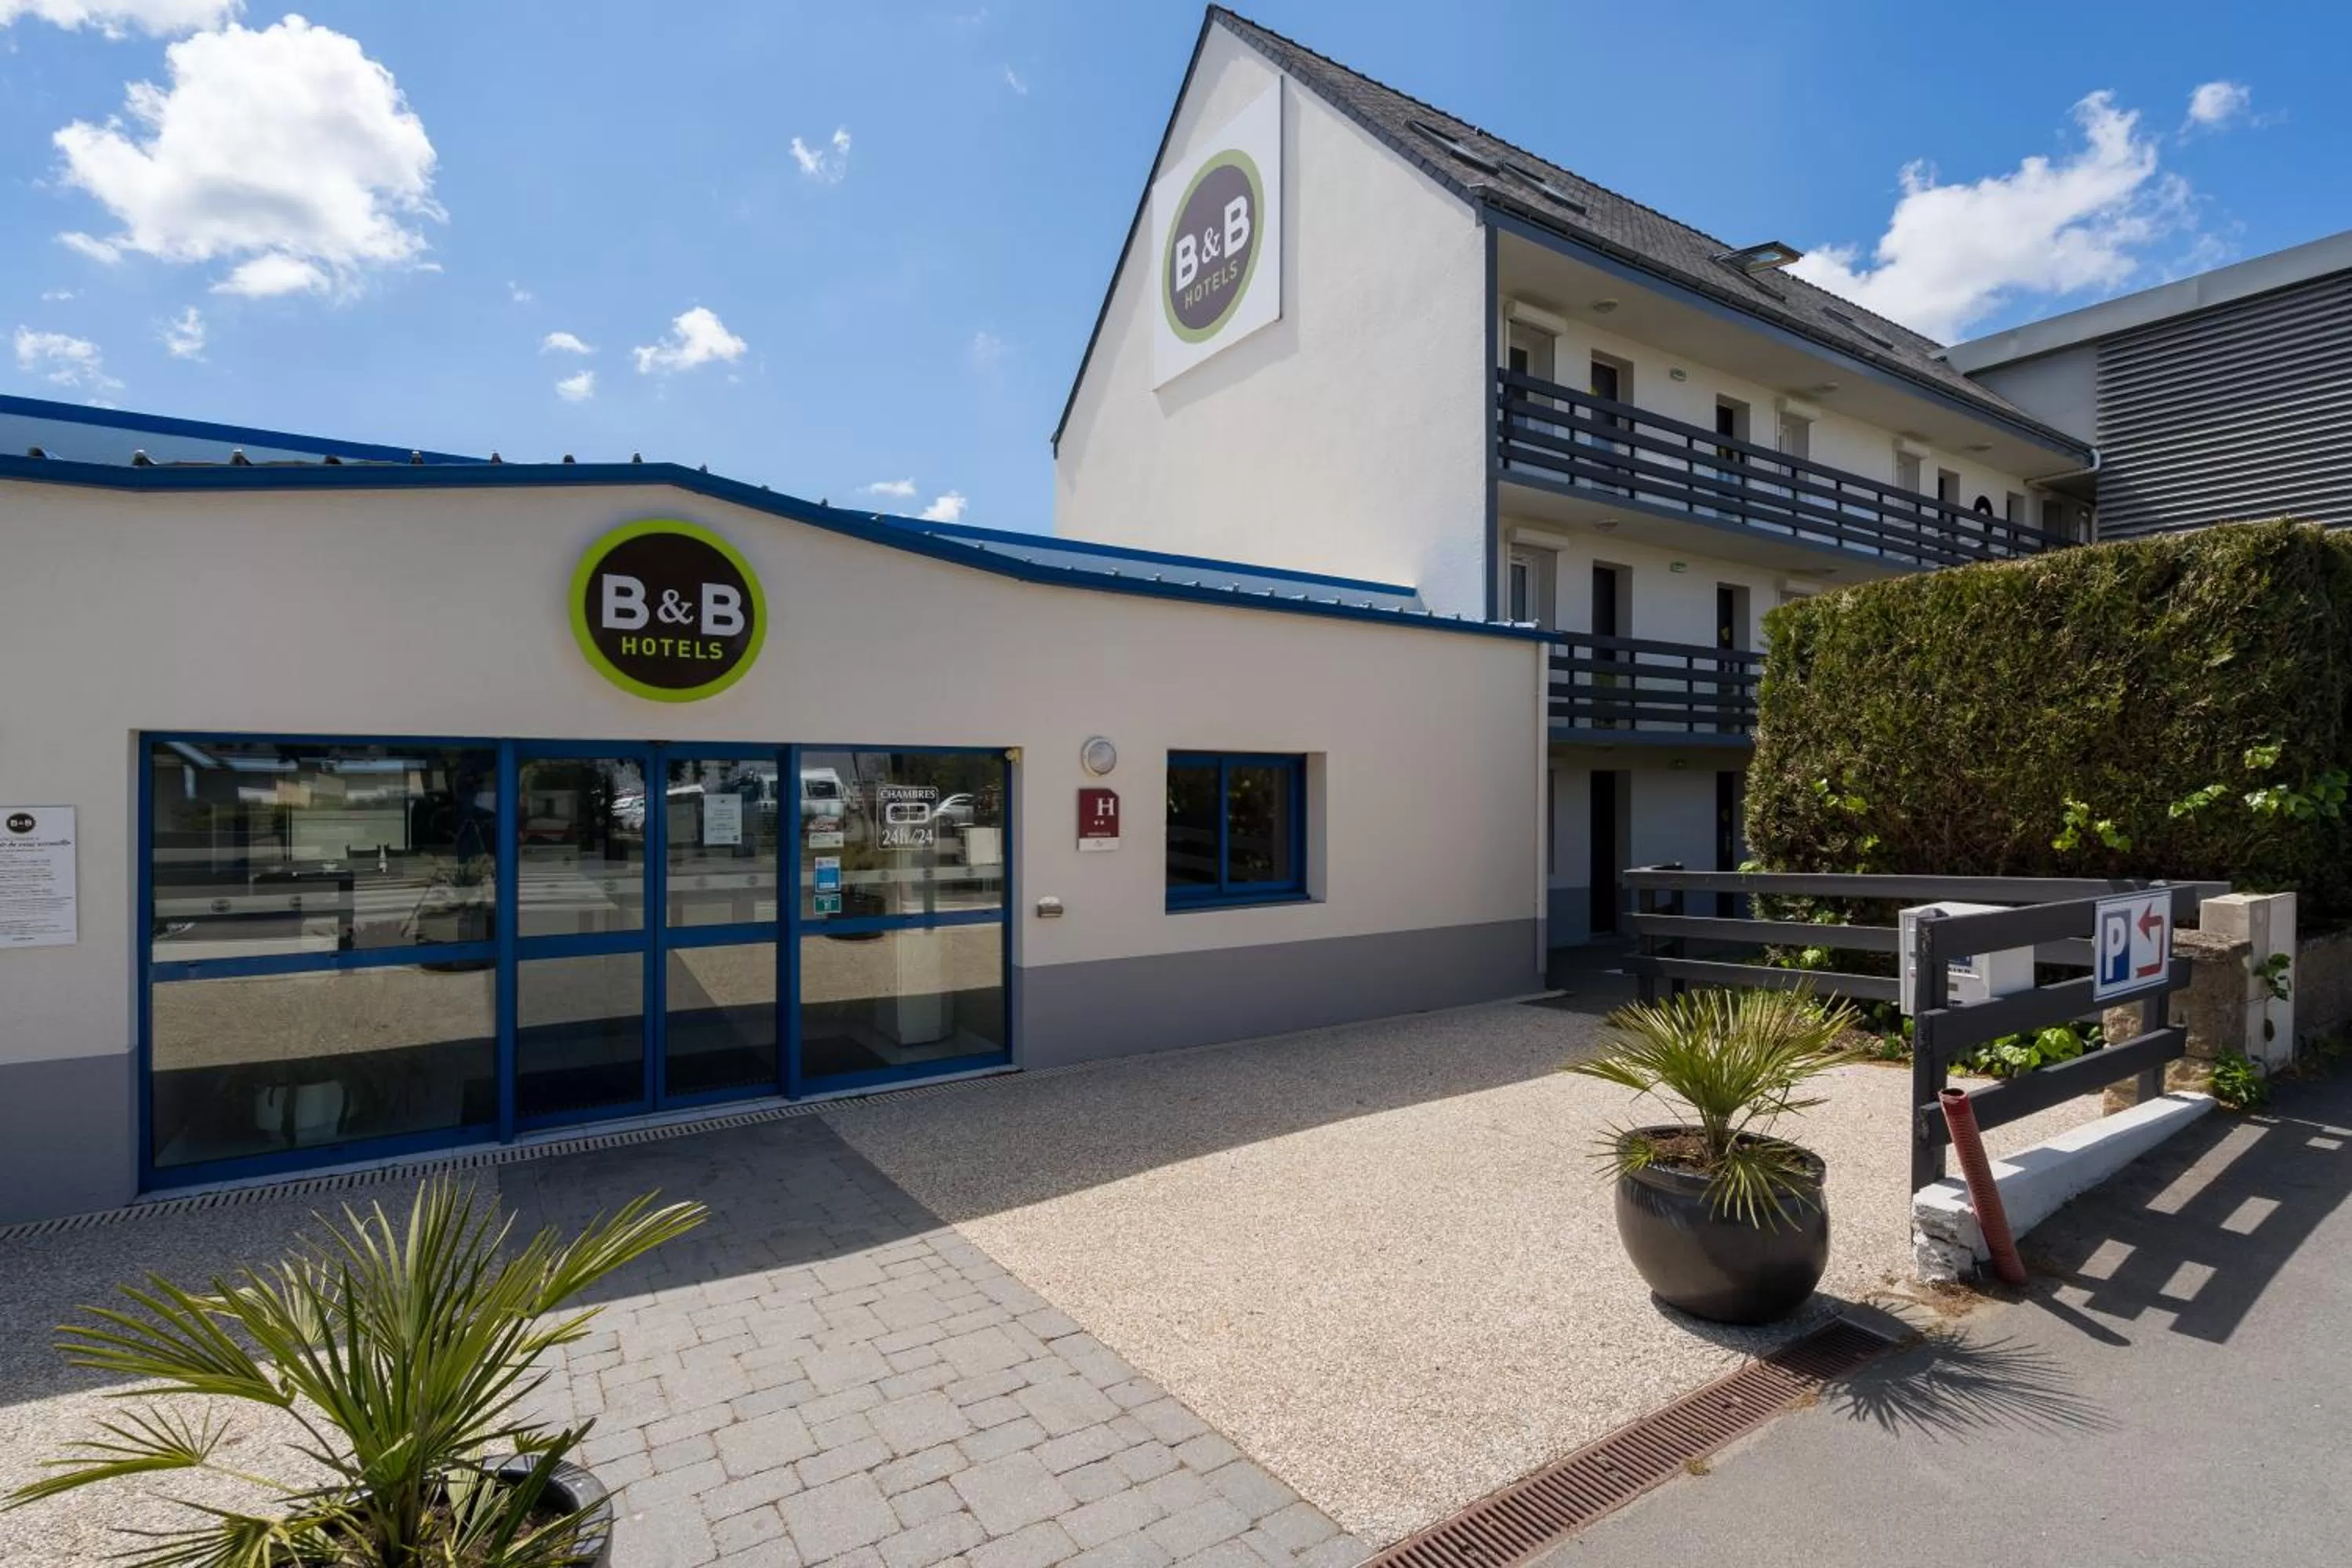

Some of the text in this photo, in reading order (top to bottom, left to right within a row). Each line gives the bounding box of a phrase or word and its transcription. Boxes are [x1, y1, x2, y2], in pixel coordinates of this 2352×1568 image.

[1185, 260, 1239, 310] HOTELS
[621, 636, 724, 660] HOTELS
[880, 789, 936, 800] CHAMBRES
[1096, 797, 1116, 817] H
[2105, 916, 2127, 980] P
